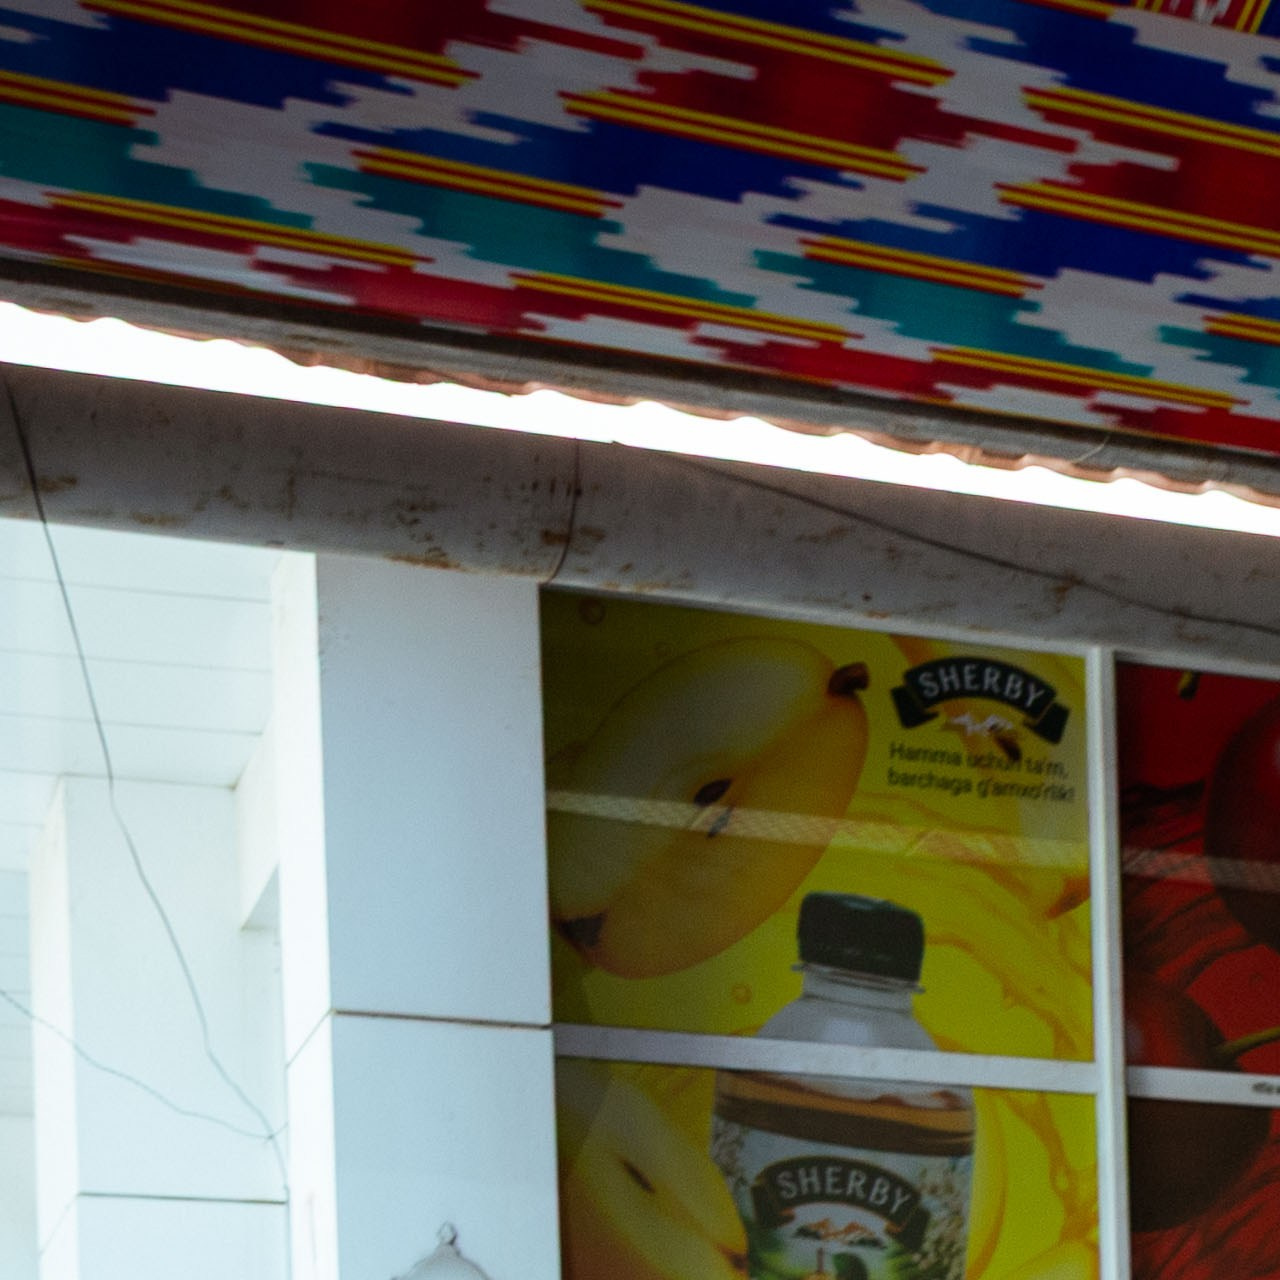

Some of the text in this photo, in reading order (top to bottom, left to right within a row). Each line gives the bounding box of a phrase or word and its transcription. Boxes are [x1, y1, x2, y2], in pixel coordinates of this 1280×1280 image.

[918, 663, 1045, 708] SHERBY
[889, 742, 962, 766] Hamma
[888, 767, 972, 796] barchaga
[776, 1165, 912, 1214] SHERBY
